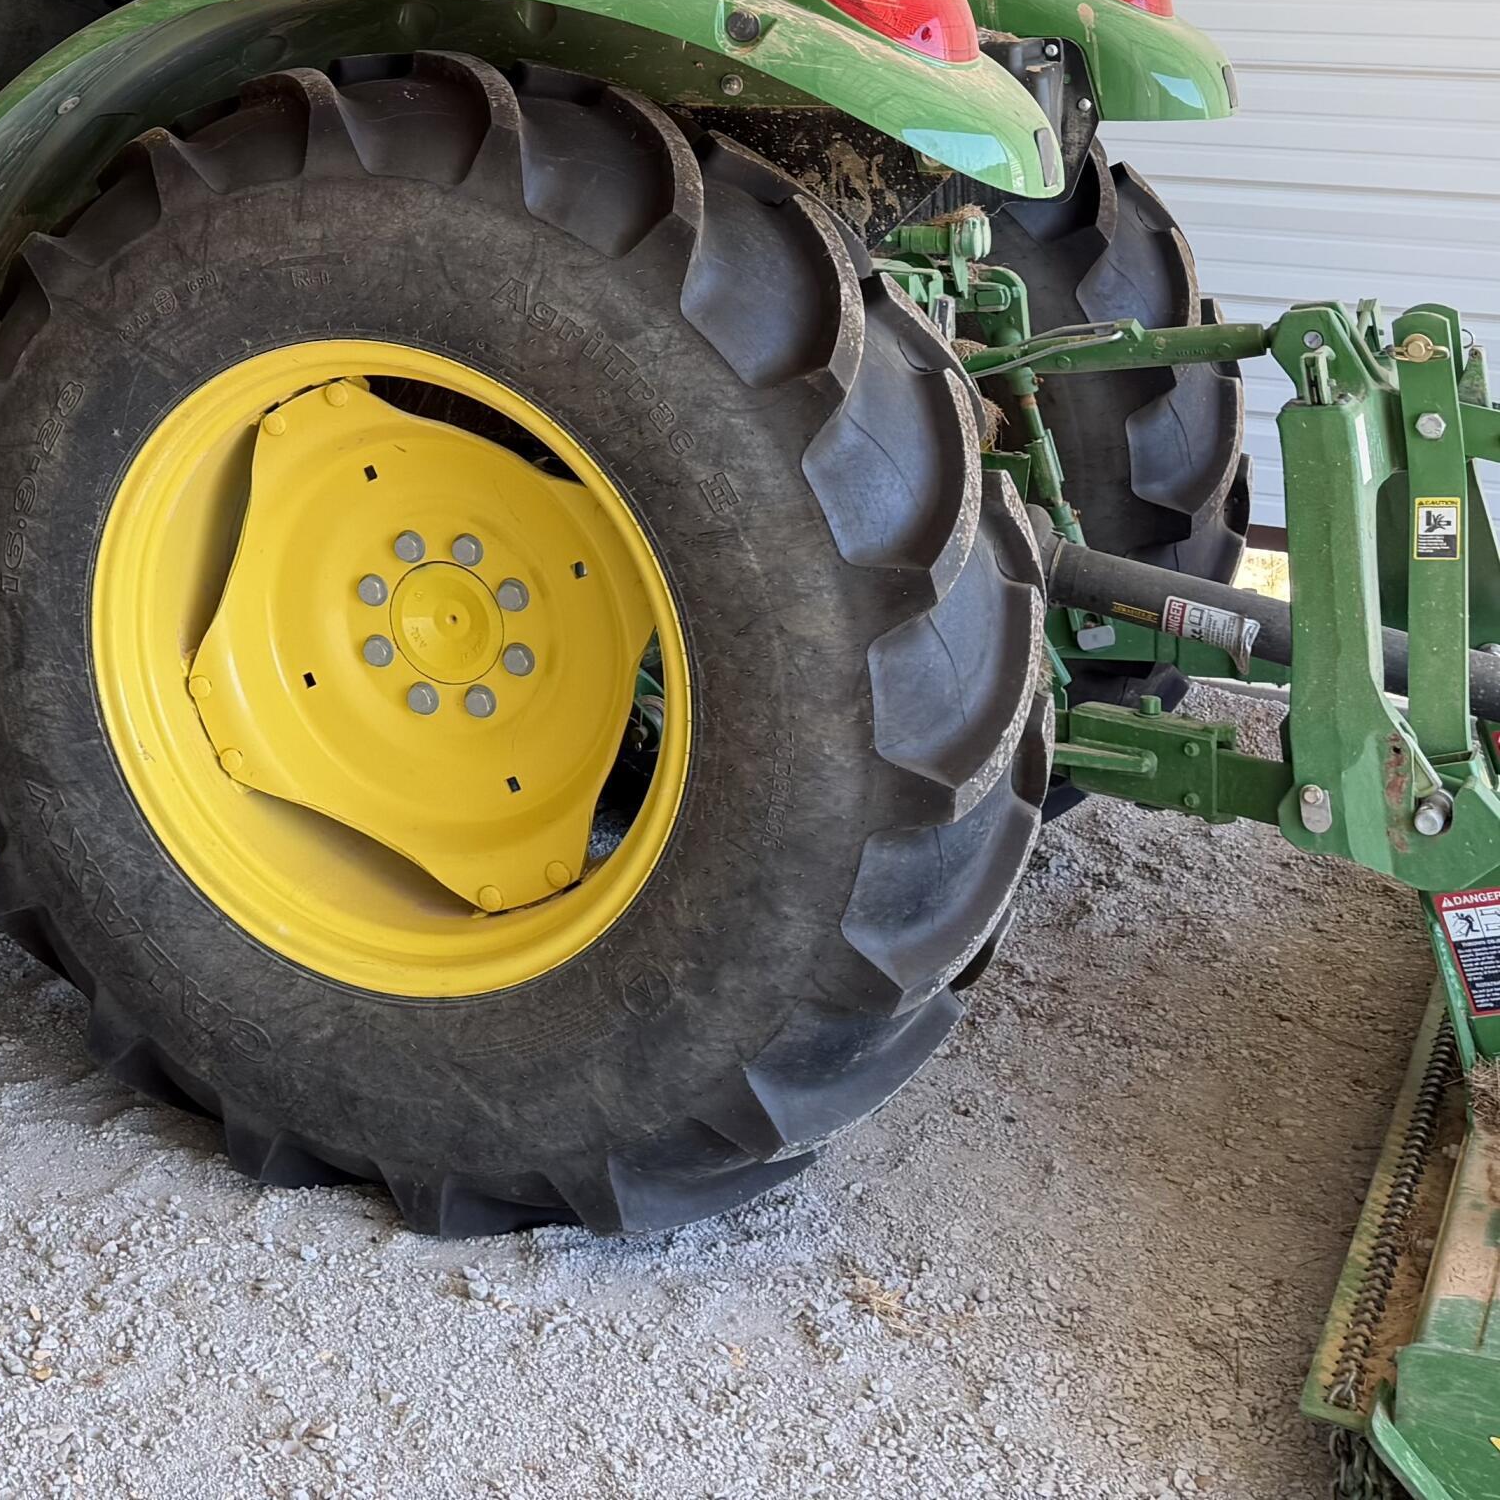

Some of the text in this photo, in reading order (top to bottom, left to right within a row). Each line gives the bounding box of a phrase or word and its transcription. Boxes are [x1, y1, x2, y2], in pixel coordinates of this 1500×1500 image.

[490, 276, 697, 456] AgriTrac
[1, 380, 85, 593] 16.9-28
[25, 779, 273, 1065] GALAXY
[1453, 891, 1500, 906] DANGER
